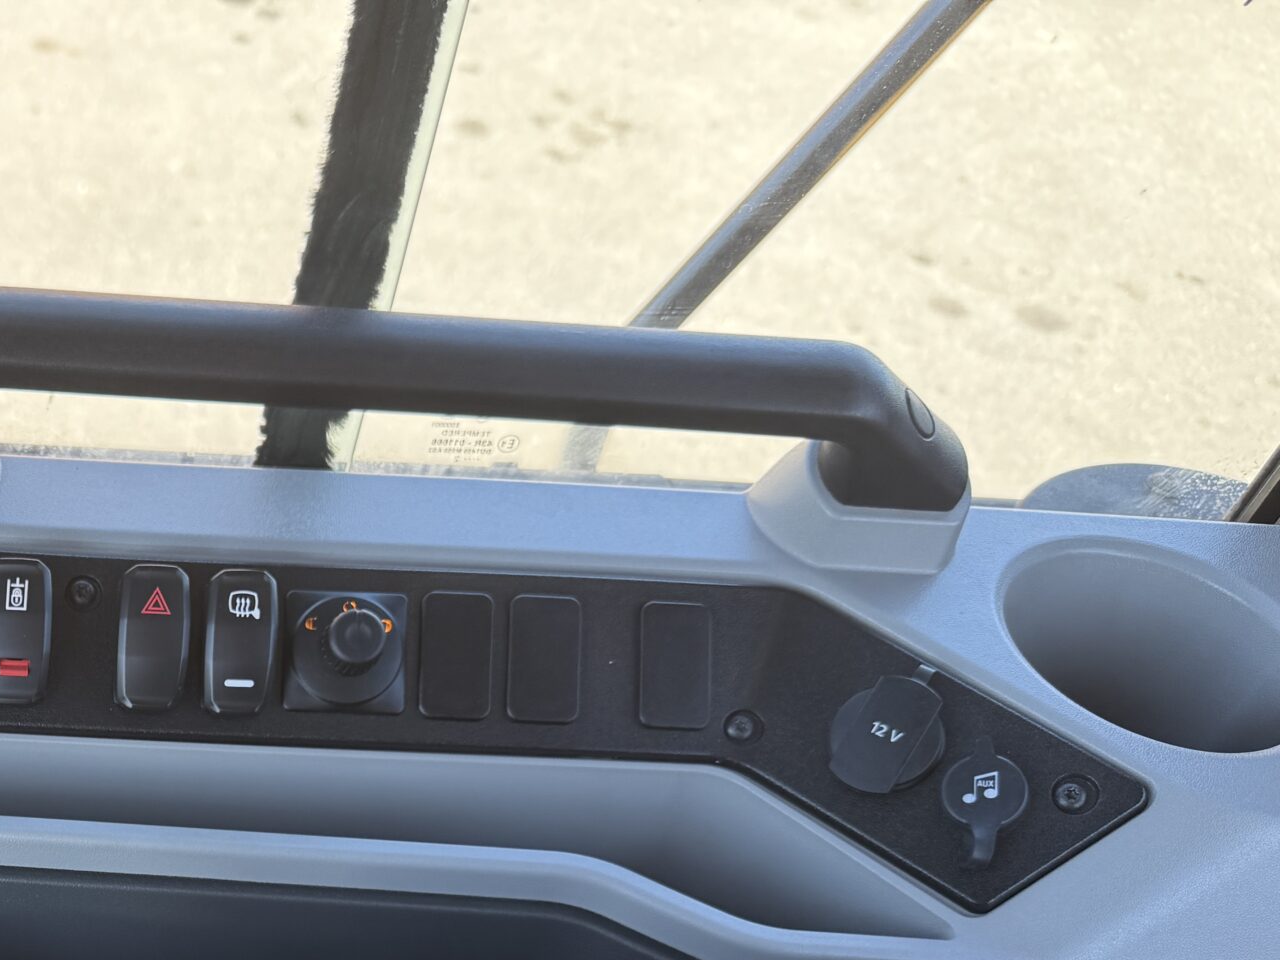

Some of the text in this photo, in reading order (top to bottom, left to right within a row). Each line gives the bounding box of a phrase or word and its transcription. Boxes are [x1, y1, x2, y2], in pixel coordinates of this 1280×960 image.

[870, 720, 905, 743] 12 V
[976, 780, 994, 788] AUX
